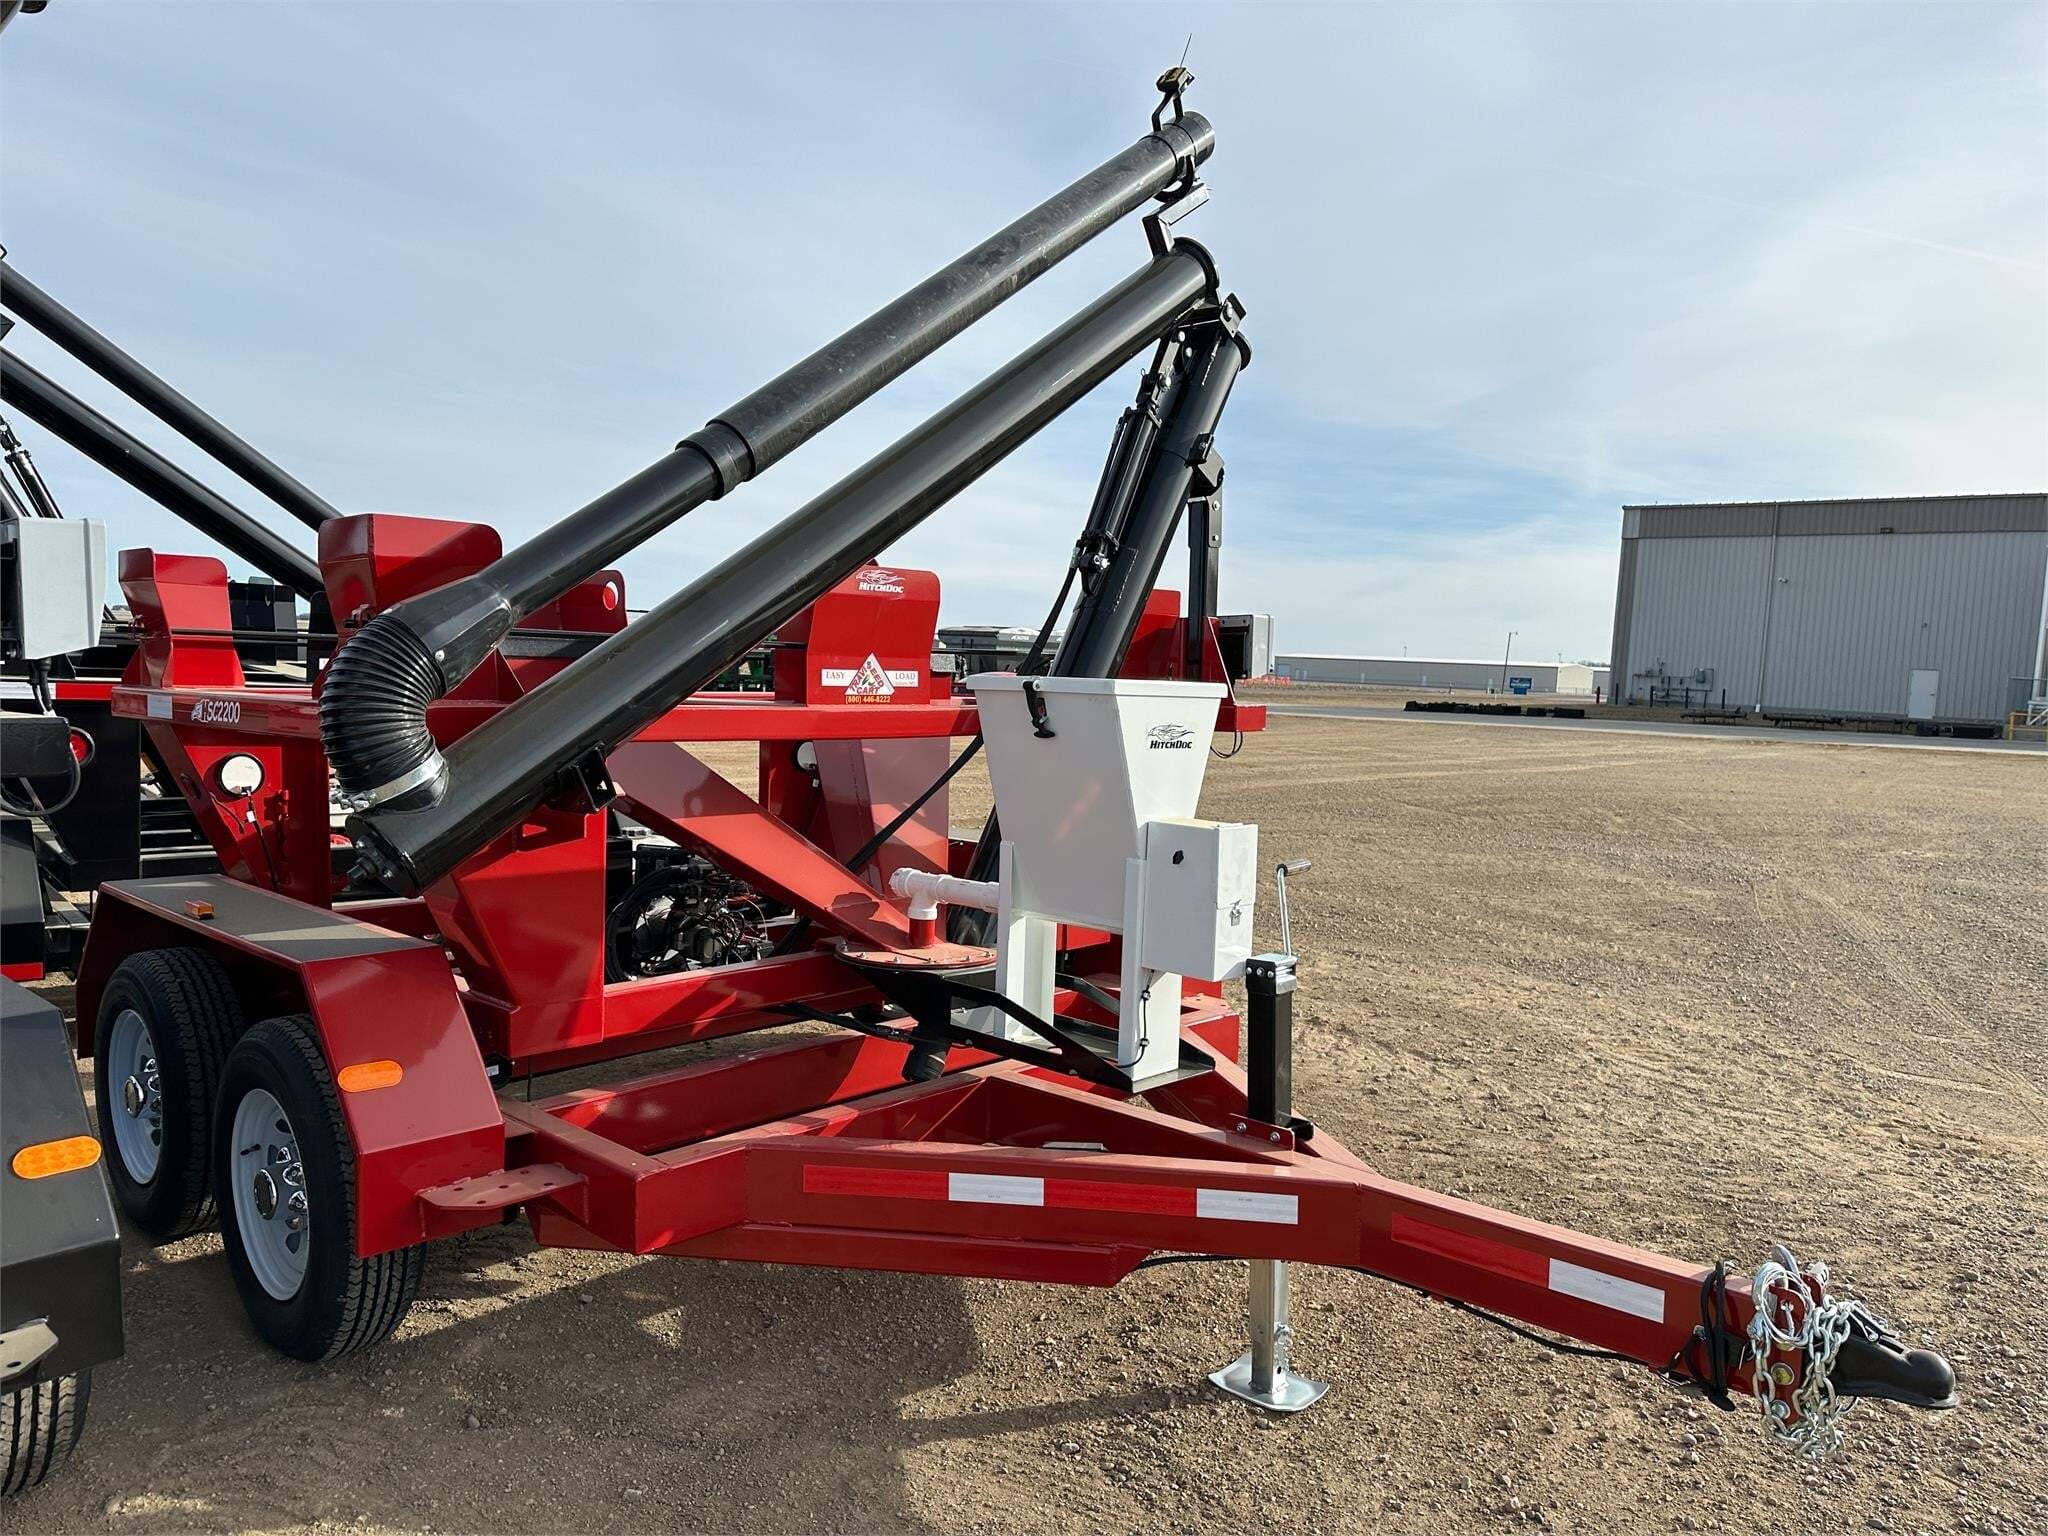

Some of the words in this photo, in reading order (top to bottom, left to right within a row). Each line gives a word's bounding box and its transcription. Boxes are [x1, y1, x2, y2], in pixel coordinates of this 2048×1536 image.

[825, 671, 846, 680] EASY
[895, 672, 916, 681] LOAD
[856, 687, 881, 695] CART
[845, 695, 861, 705] (800)
[1150, 740, 1193, 750] HITCHDOC
